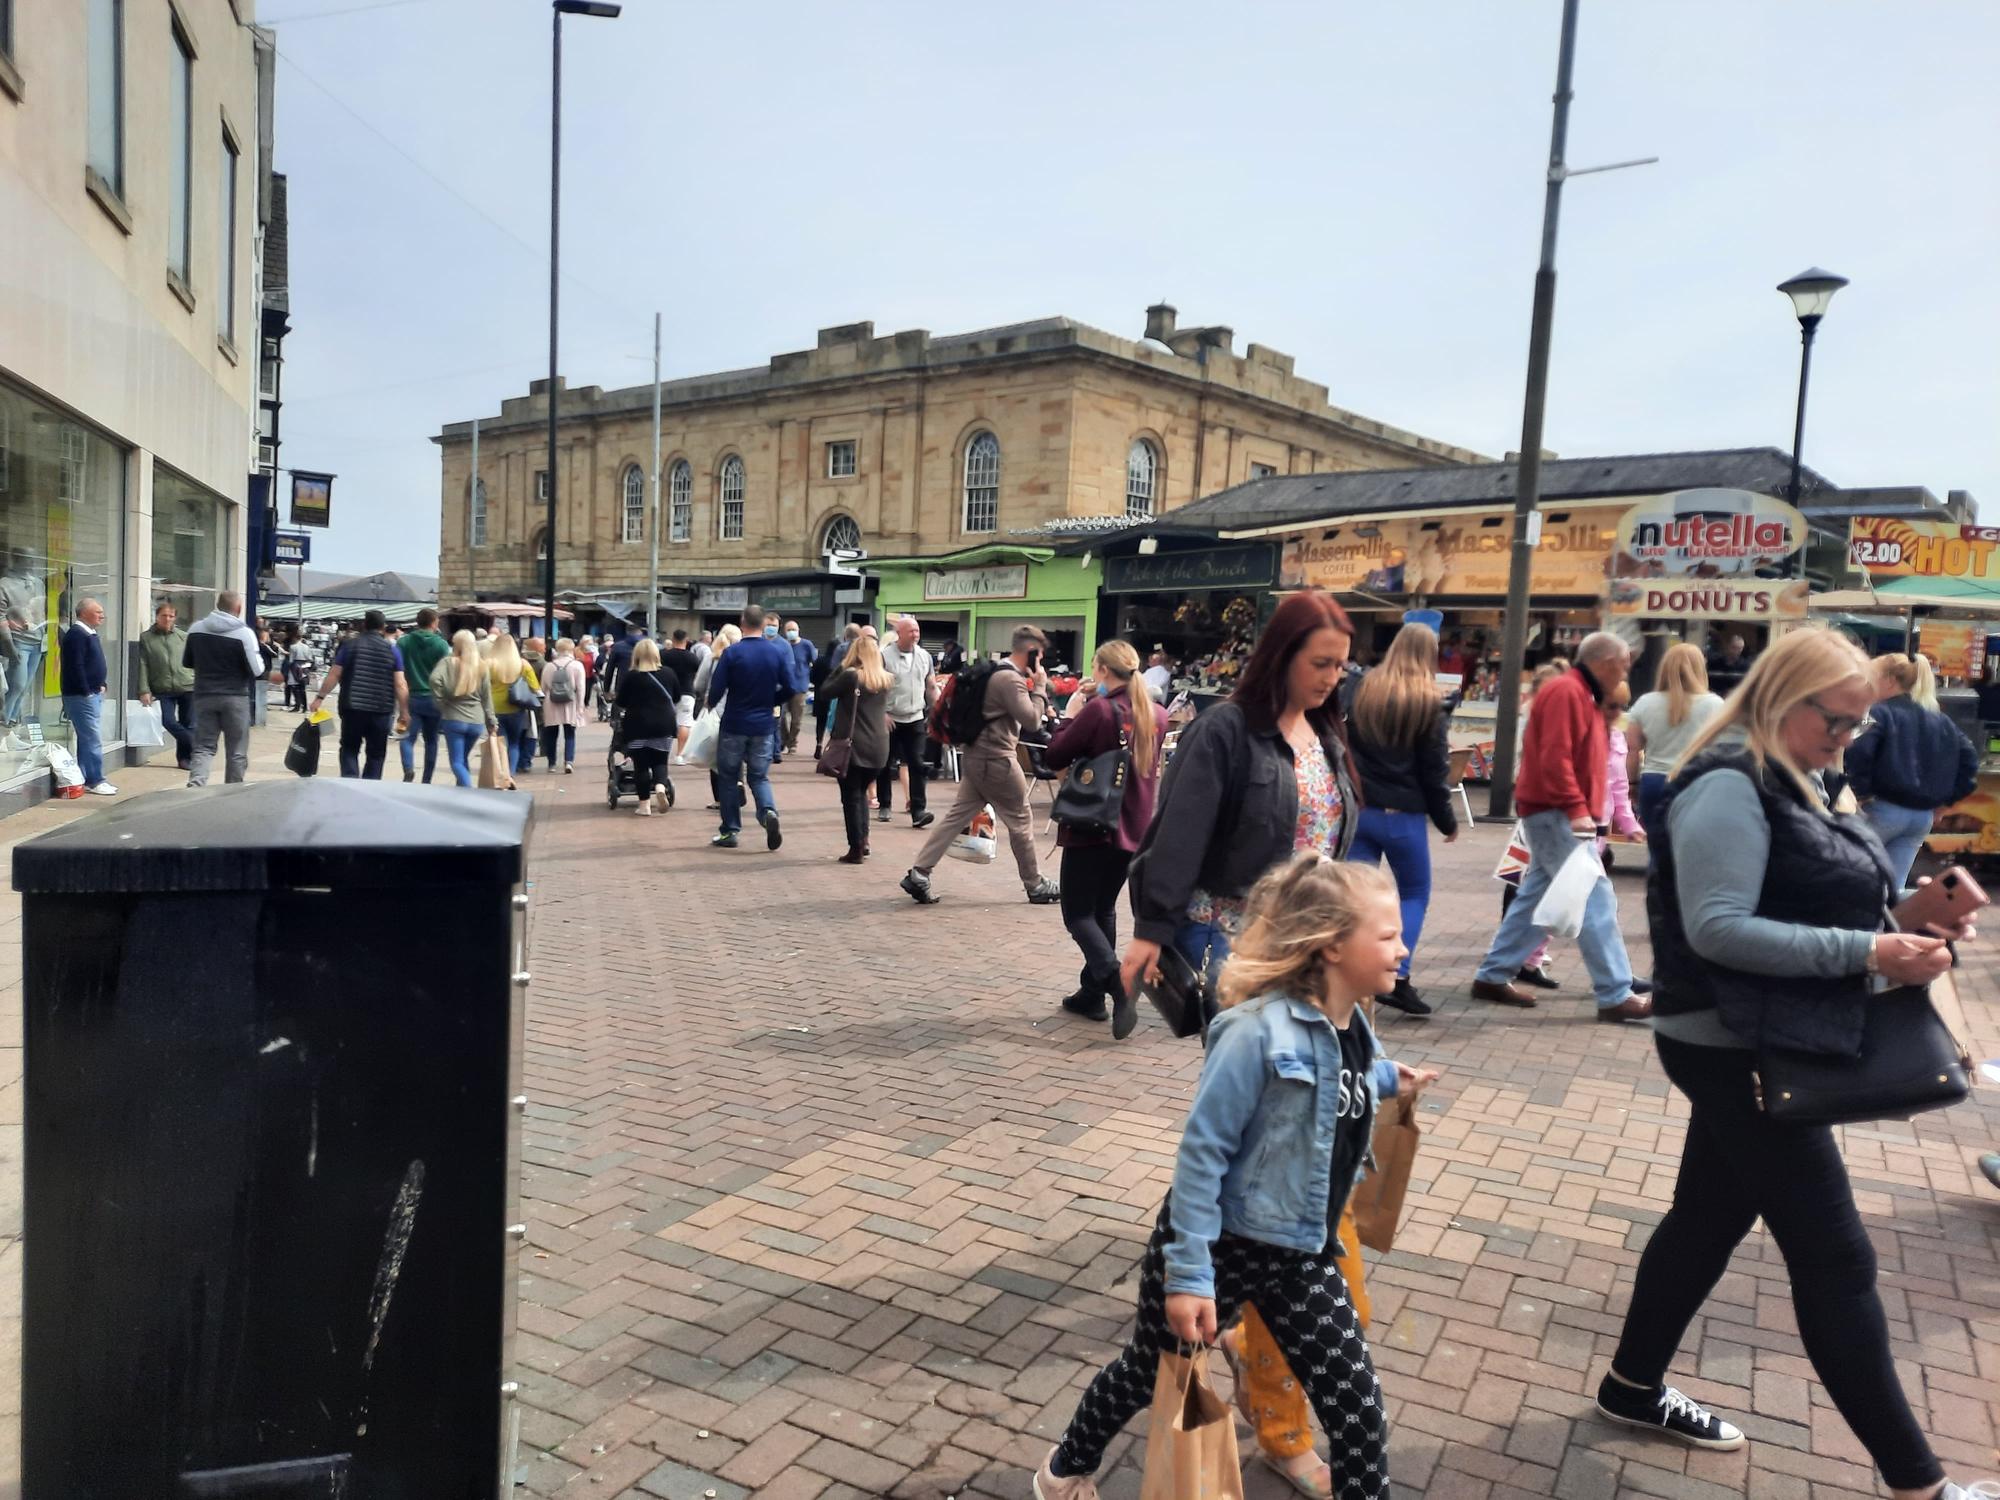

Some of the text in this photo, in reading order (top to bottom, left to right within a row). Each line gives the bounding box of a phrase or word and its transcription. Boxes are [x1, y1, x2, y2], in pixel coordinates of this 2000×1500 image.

[1639, 514, 1786, 547] nutella
[1323, 563, 1356, 575] COFFEE
[1915, 536, 1997, 577] HOT
[927, 569, 990, 596] Clarkson's
[1647, 591, 1772, 613] DONUTS
